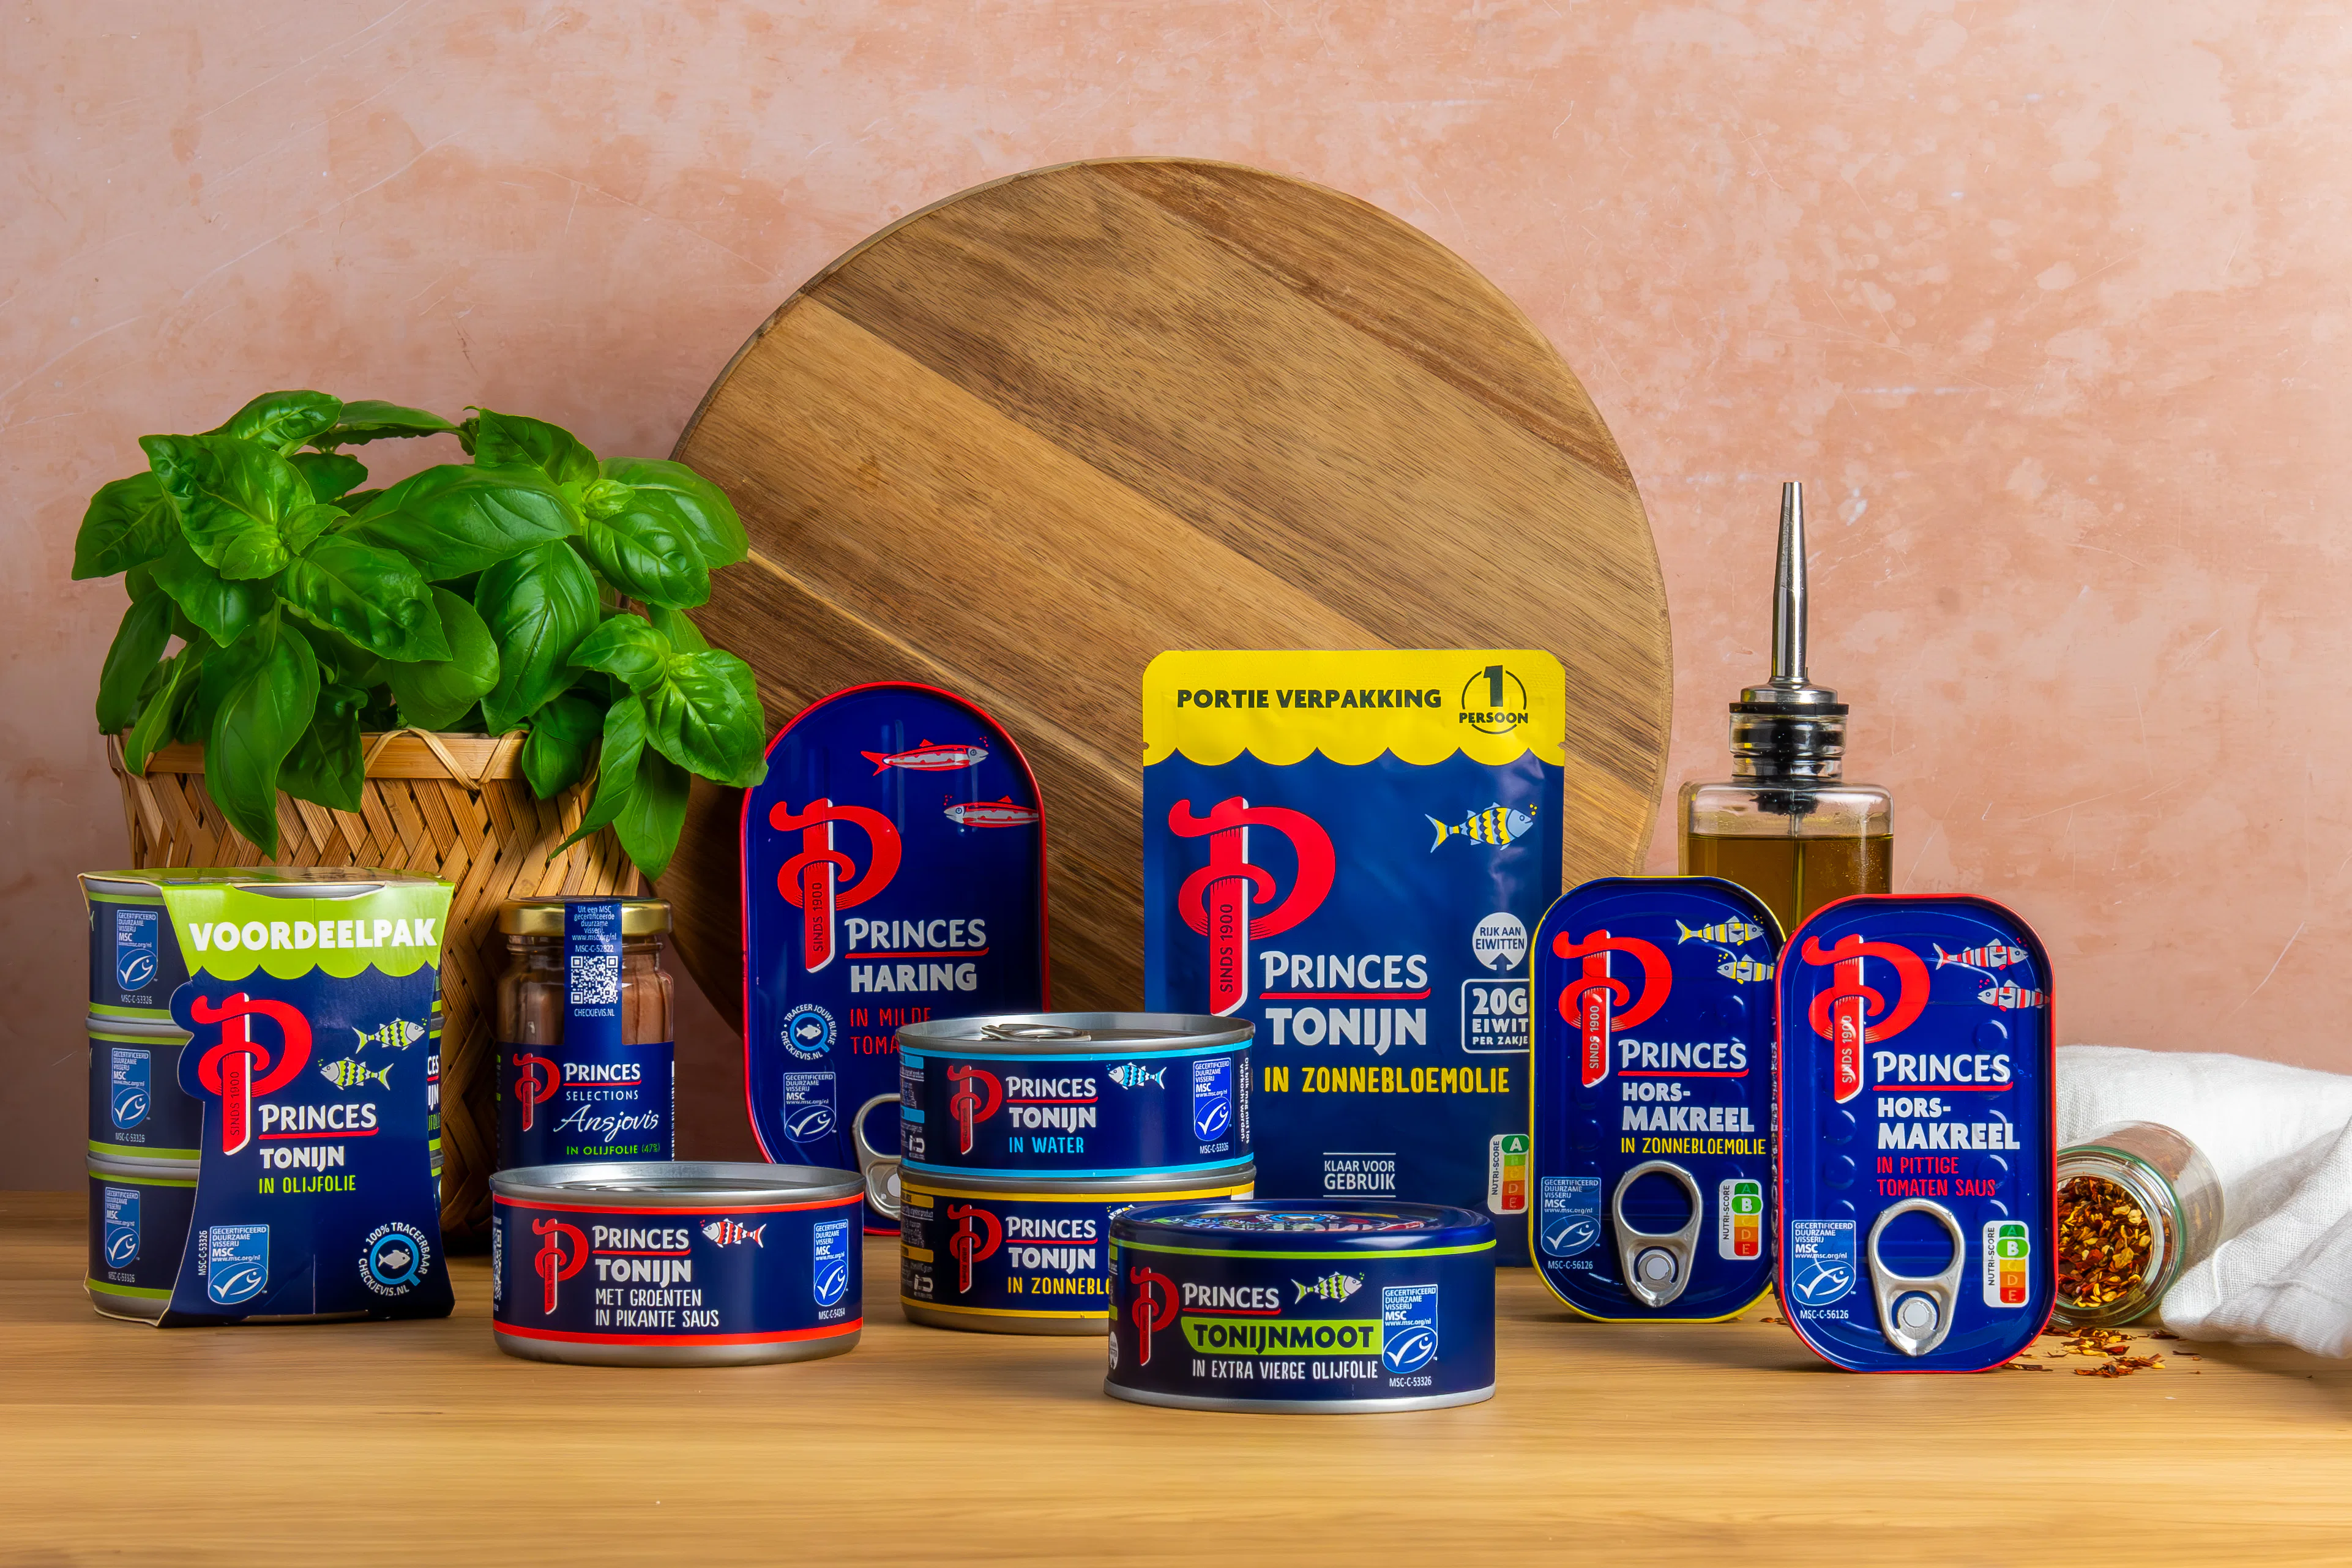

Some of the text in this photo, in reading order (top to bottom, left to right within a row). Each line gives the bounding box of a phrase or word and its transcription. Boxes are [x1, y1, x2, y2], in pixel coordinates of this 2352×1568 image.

[1484, 665, 1503, 707] 1
[1177, 689, 1441, 708] PORTIE VERPAKKING
[1459, 712, 1528, 723] PERSOON
[812, 882, 823, 952] SINDS 1900
[119, 933, 133, 941] MSC
[189, 918, 438, 952] VOORDEELPAK
[845, 918, 986, 950] PRINCES
[1480, 927, 1521, 936] RIJK AAN
[1220, 904, 1233, 993] SINDS 1900
[1476, 938, 1525, 949] EIWITTEN
[851, 963, 977, 992] HARING
[1260, 950, 1428, 988] PRINCES
[1473, 988, 1527, 1015] 20G
[784, 1004, 837, 1045] TRACEER JOUW BLIKJE
[850, 1009, 868, 1027] IN
[1473, 1018, 1528, 1032] EIWIT
[1266, 1007, 1427, 1056] TONIJN
[1589, 1006, 1599, 1069] SINDS 1900
[1842, 1015, 1852, 1043] 1900
[781, 1031, 823, 1060] CHECKJEVIS.NL
[850, 1036, 899, 1055] TOMA
[1473, 1036, 1528, 1046] PER ZAKJE
[1618, 1039, 1746, 1069] PRINCES
[563, 1063, 641, 1081] PRINCES
[1195, 1061, 1230, 1070] GECERTIFICEERD
[1195, 1068, 1221, 1077] DUURZAME
[1873, 1051, 2010, 1082] PRINCES
[114, 1071, 127, 1080] MSC
[1264, 1067, 1509, 1093] IN ZONNEBLOEMOLIE
[566, 1090, 638, 1101] SELECTIONS
[1006, 1076, 1096, 1097] PRINCES
[1196, 1083, 1211, 1092] MSC
[1622, 1082, 1690, 1101] HORS-
[230, 1071, 239, 1135] SINDS 1900
[1878, 1097, 1951, 1118] HORS-
[258, 1103, 376, 1132] PRINCES
[553, 1104, 659, 1142] Ansjovis
[1009, 1107, 1096, 1133] TONIJN
[1622, 1106, 1755, 1132] MAKREEL
[1009, 1137, 1084, 1153] IN WATER
[1509, 1137, 1523, 1151] A
[1878, 1123, 2020, 1149] MAKREEL
[567, 1146, 578, 1155] IN
[583, 1145, 638, 1155] OLIJFOLIE
[1621, 1138, 1766, 1154] IN ZONNEBLOEMOLIE
[259, 1146, 344, 1172] TONIJN
[1324, 1160, 1395, 1172] KLAAR VOOR
[1877, 1156, 1959, 1174] IN PITTIGE
[259, 1175, 356, 1194] IN OLIJFOLIE
[1324, 1173, 1395, 1190] GEBRUIK
[1876, 1179, 1996, 1196] TOMATEN SAUS
[1741, 1198, 1752, 1212] B
[816, 1230, 840, 1239] DUURZAME
[1006, 1216, 1096, 1238] PRINCES
[592, 1225, 689, 1249] PRINCES
[198, 1230, 207, 1275] MSC-C-53326
[212, 1248, 234, 1256] MSC
[365, 1222, 430, 1274] 100% TRACEERBAAR
[816, 1245, 831, 1256] MSC
[1795, 1244, 1818, 1253] MSC
[2007, 1241, 2019, 1256] B
[1009, 1247, 1096, 1274] TONIJN
[1548, 1261, 1593, 1269] MSC-C-56126
[359, 1258, 409, 1296] CHECKJEVIS.NL
[595, 1259, 692, 1288] TONIJN
[1008, 1277, 1022, 1293] IN
[1385, 1288, 1436, 1296] GECERTIFICEERD
[595, 1288, 701, 1306] MET GROENTEN
[1182, 1283, 1279, 1309] PRINCES
[595, 1309, 719, 1327] IN PIKANTE SAUS
[1385, 1311, 1407, 1321] MSC
[1385, 1318, 1431, 1326] www.msc.org/nl
[1800, 1310, 1848, 1319] MSC-C-56126
[1193, 1324, 1374, 1354] TONIJNMOOT
[1193, 1359, 1378, 1379] IN EXTRA VIERGE OLIJFOLIE
[1389, 1376, 1432, 1387] MSC-C-53326
